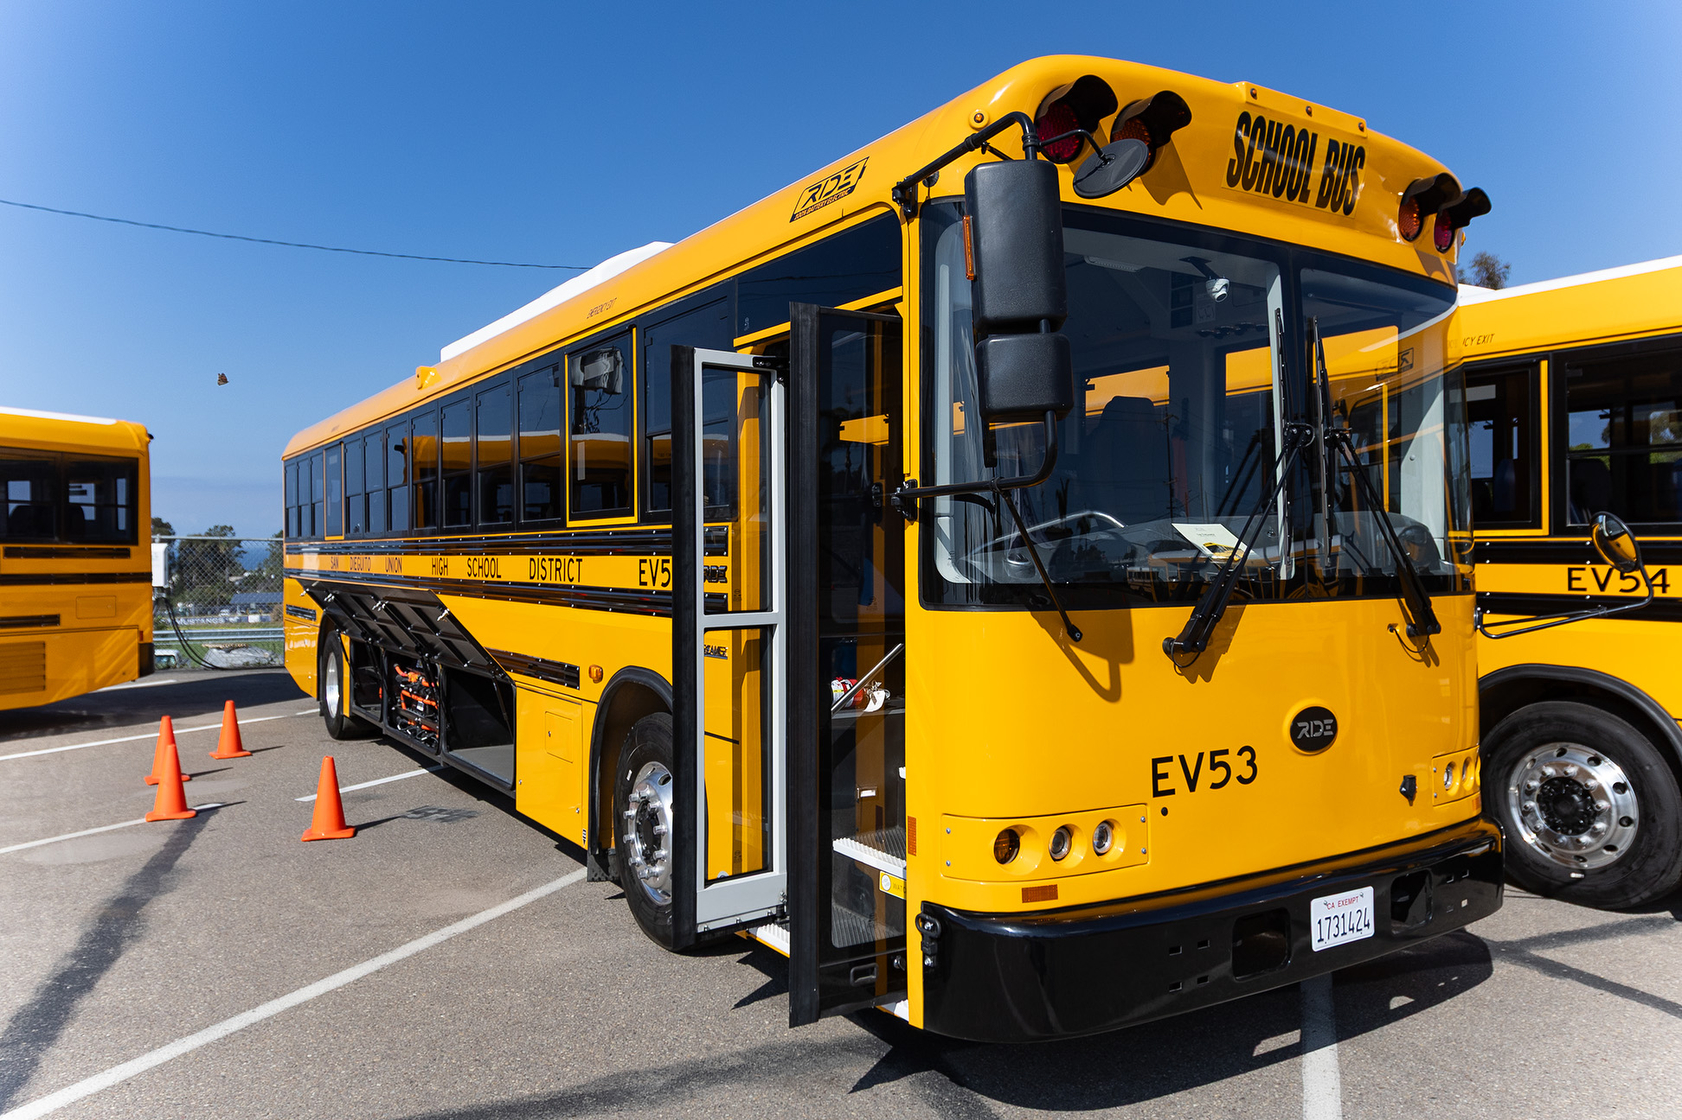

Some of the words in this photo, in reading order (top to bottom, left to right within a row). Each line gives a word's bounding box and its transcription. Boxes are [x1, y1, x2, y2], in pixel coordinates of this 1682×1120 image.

[1226, 111, 1318, 203] SCHOOL
[1315, 138, 1366, 216] BUS
[800, 164, 861, 209] RIDE
[1476, 333, 1495, 345] EXIT
[330, 556, 339, 569] SAN
[350, 556, 372, 571] DIEGUITO
[385, 556, 403, 573] UNION
[432, 557, 449, 576] HIGH
[467, 557, 502, 579] SCHOOL
[529, 557, 583, 583] DISTRICT
[638, 558, 671, 588] EV5
[1567, 567, 1671, 594] EV54
[1297, 719, 1334, 739] RIDE
[1151, 745, 1258, 798] EV53
[1326, 902, 1335, 910] CA
[1337, 896, 1359, 908] EXEMPT
[1317, 907, 1371, 943] 1731424
